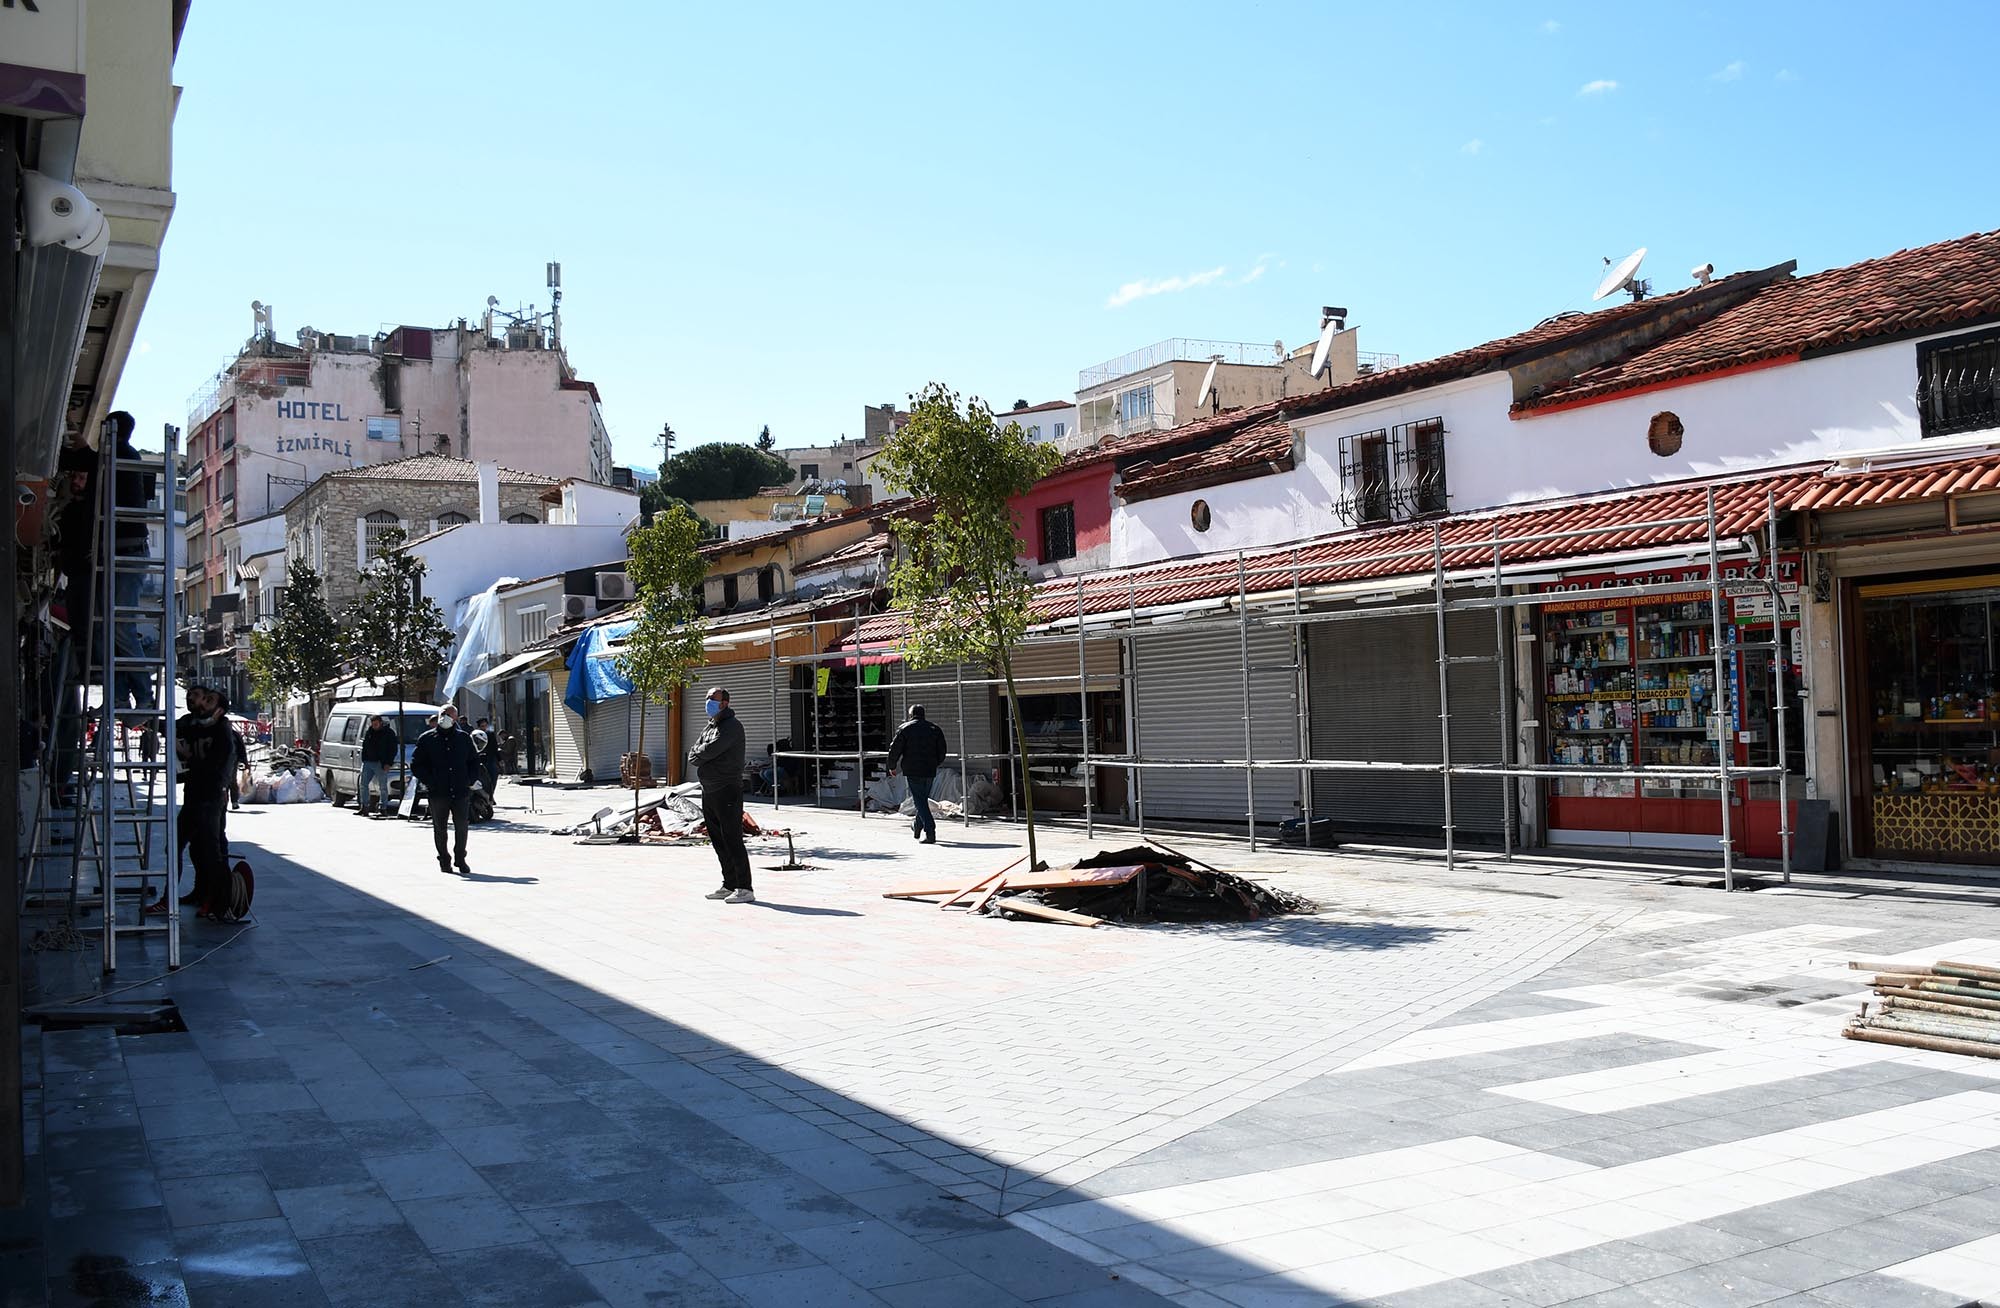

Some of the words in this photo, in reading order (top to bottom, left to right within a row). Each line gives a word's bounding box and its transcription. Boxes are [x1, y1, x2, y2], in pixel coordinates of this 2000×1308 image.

[277, 401, 349, 421] HOTEL
[277, 432, 352, 458] İZMİRLİ
[1603, 598, 1630, 608] LARGEST
[1631, 594, 1663, 606] INVENTORY
[1665, 593, 1672, 602] IN
[1673, 590, 1704, 602] SMALLEST
[1780, 613, 1797, 621] STORE
[1637, 690, 1668, 698] TOBACCO
[1669, 689, 1688, 697] SHOP
